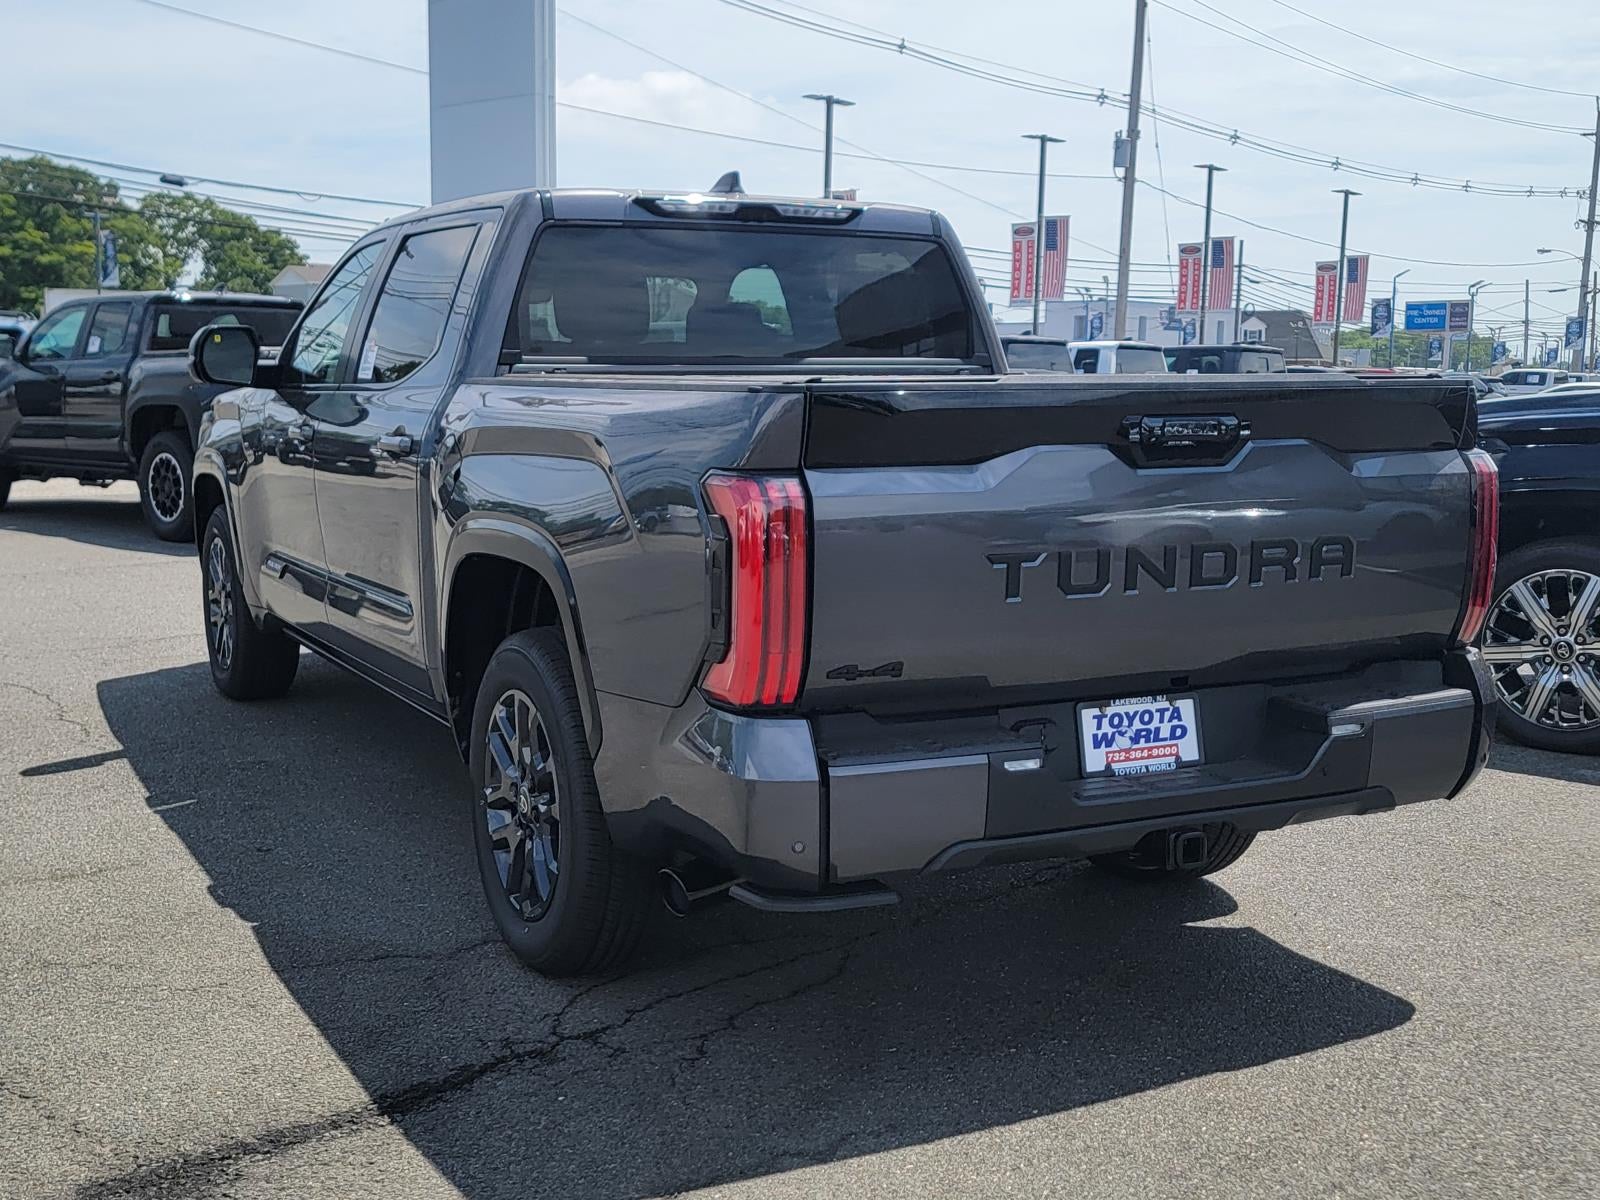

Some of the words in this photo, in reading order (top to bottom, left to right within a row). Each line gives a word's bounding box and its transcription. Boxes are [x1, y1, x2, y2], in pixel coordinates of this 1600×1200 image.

[1013, 241, 1022, 297] TOYOTA
[1179, 259, 1188, 309] TOYOTA
[1315, 275, 1323, 321] TOYOTA
[984, 535, 1356, 603] TUNDRA
[1110, 696, 1155, 707] LAKEWOOD,
[1156, 694, 1167, 702] NJ
[1092, 706, 1183, 731] TOYOTA
[1092, 724, 1188, 750] WORLD
[1107, 746, 1177, 761] 732-364-9000
[1113, 765, 1147, 776] TOYOTA
[1148, 762, 1177, 772] WORLD
